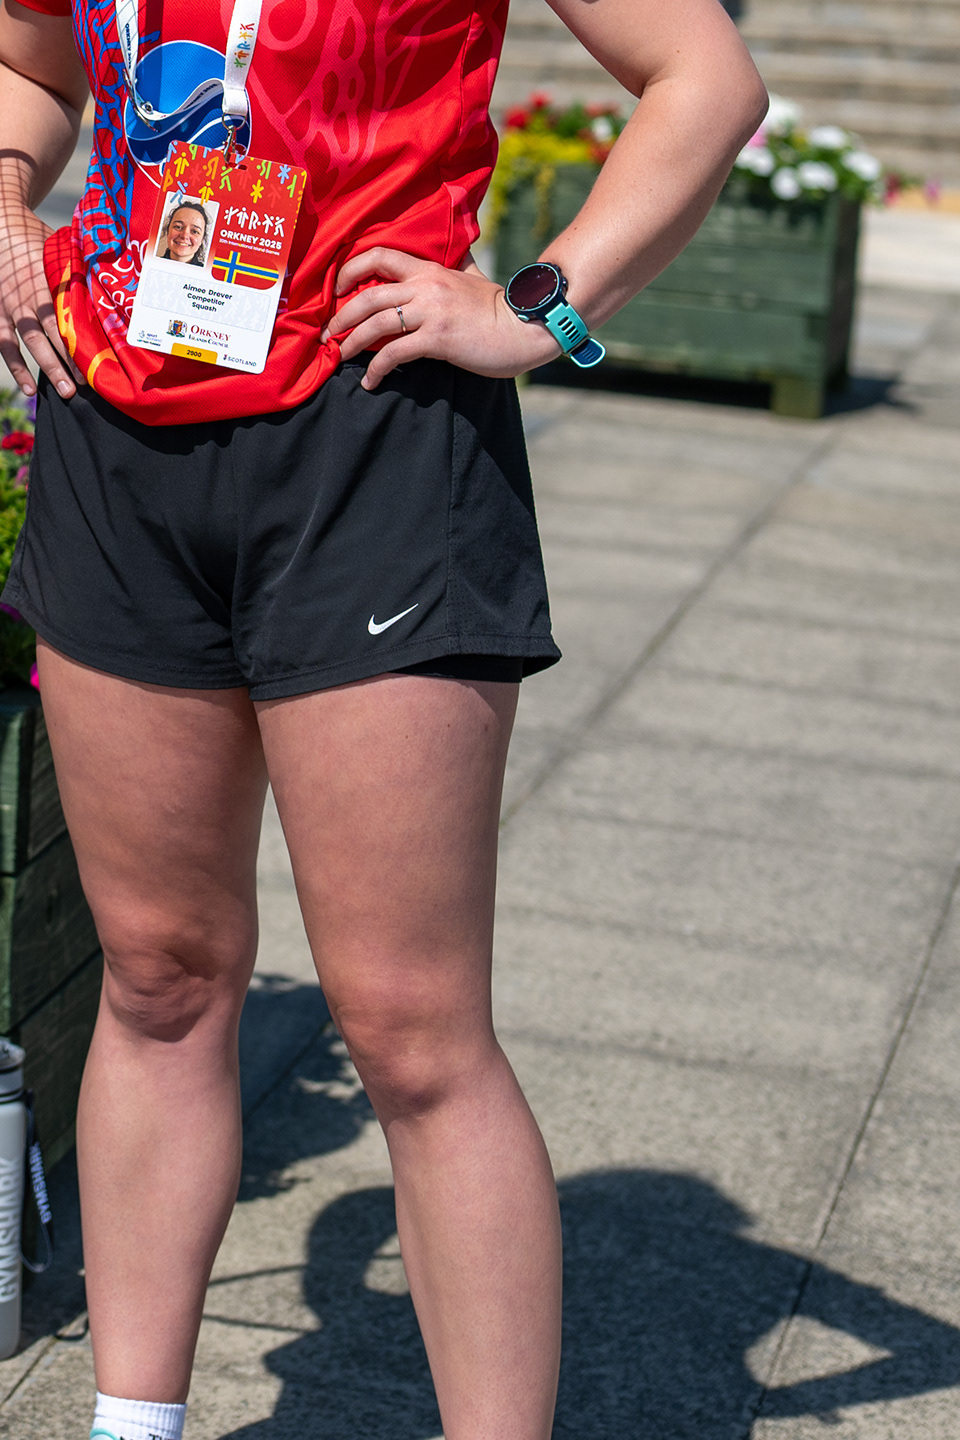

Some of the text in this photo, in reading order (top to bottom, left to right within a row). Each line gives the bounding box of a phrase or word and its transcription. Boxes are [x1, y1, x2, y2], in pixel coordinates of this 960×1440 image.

[220, 229, 282, 250] ORKNEY 2025
[182, 283, 232, 300] Aimee Drever
[187, 292, 225, 306] Competitor
[192, 301, 217, 312] Squash
[190, 324, 231, 341] ORKNEY
[228, 356, 257, 367] SCOTLAND
[29, 1142, 52, 1225] GYMSHARK
